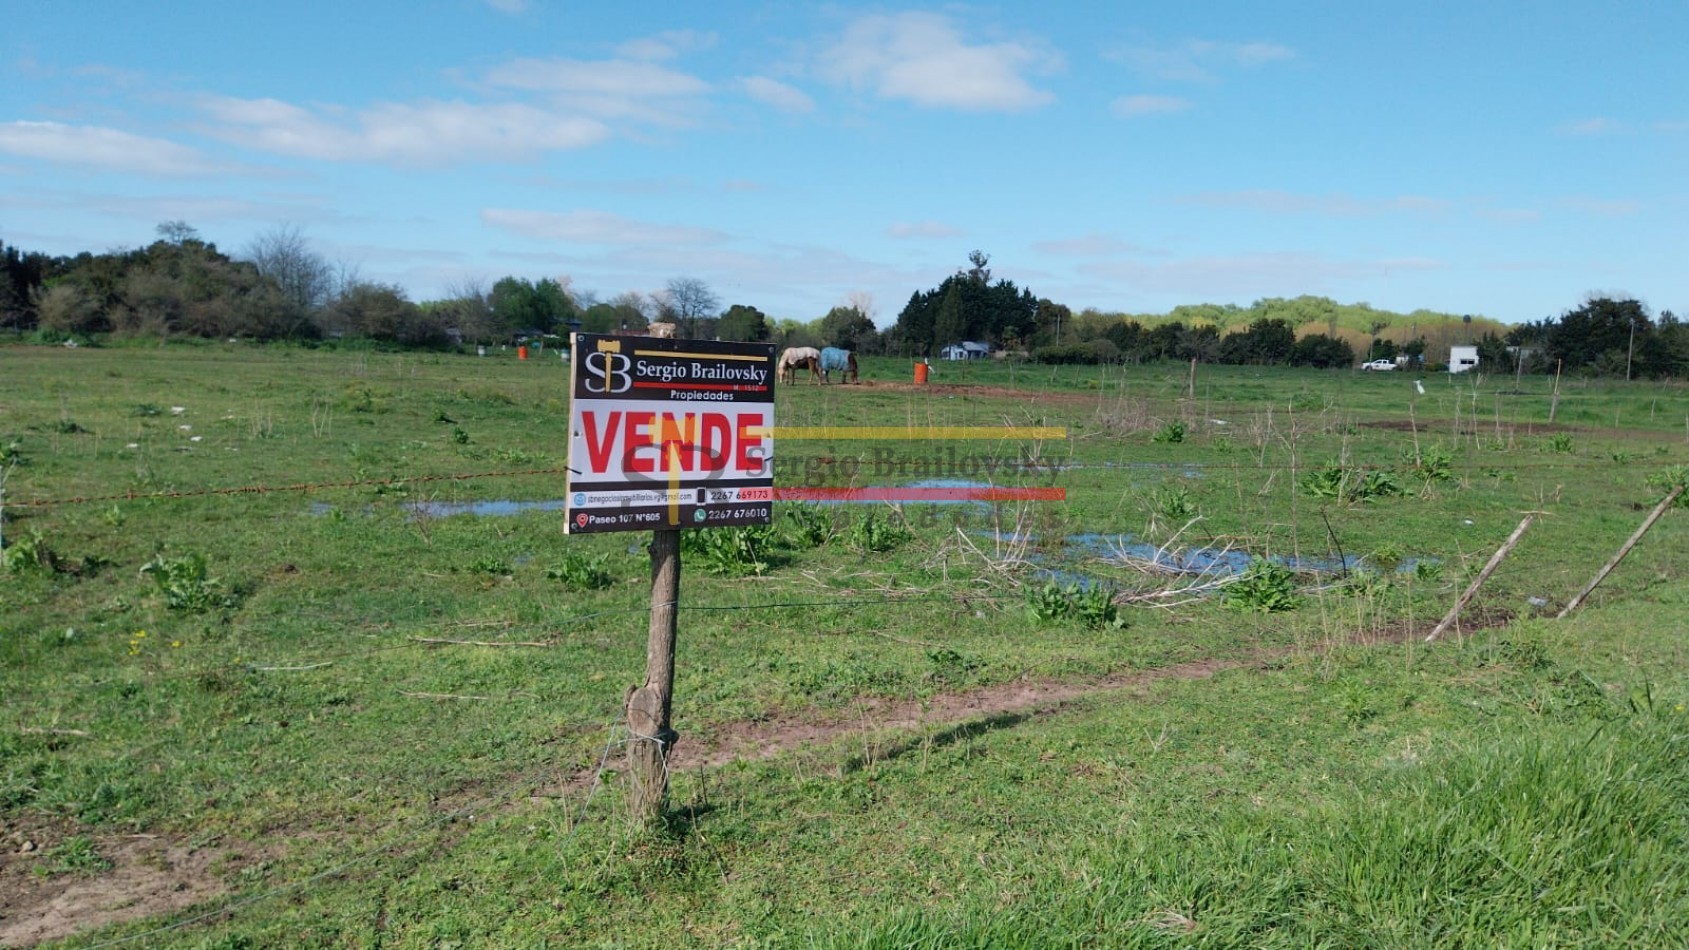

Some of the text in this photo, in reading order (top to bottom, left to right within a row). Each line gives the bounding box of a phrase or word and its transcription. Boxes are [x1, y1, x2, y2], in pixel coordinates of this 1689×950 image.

[585, 351, 632, 393] SB
[637, 360, 767, 385] Sergio Brailovsky
[670, 390, 734, 401] Propiedades
[581, 411, 764, 474] VENDE
[711, 490, 768, 500] 2267 669173
[589, 515, 616, 524] Paseo
[619, 514, 633, 523] 107
[708, 508, 767, 519] 2267 676010
